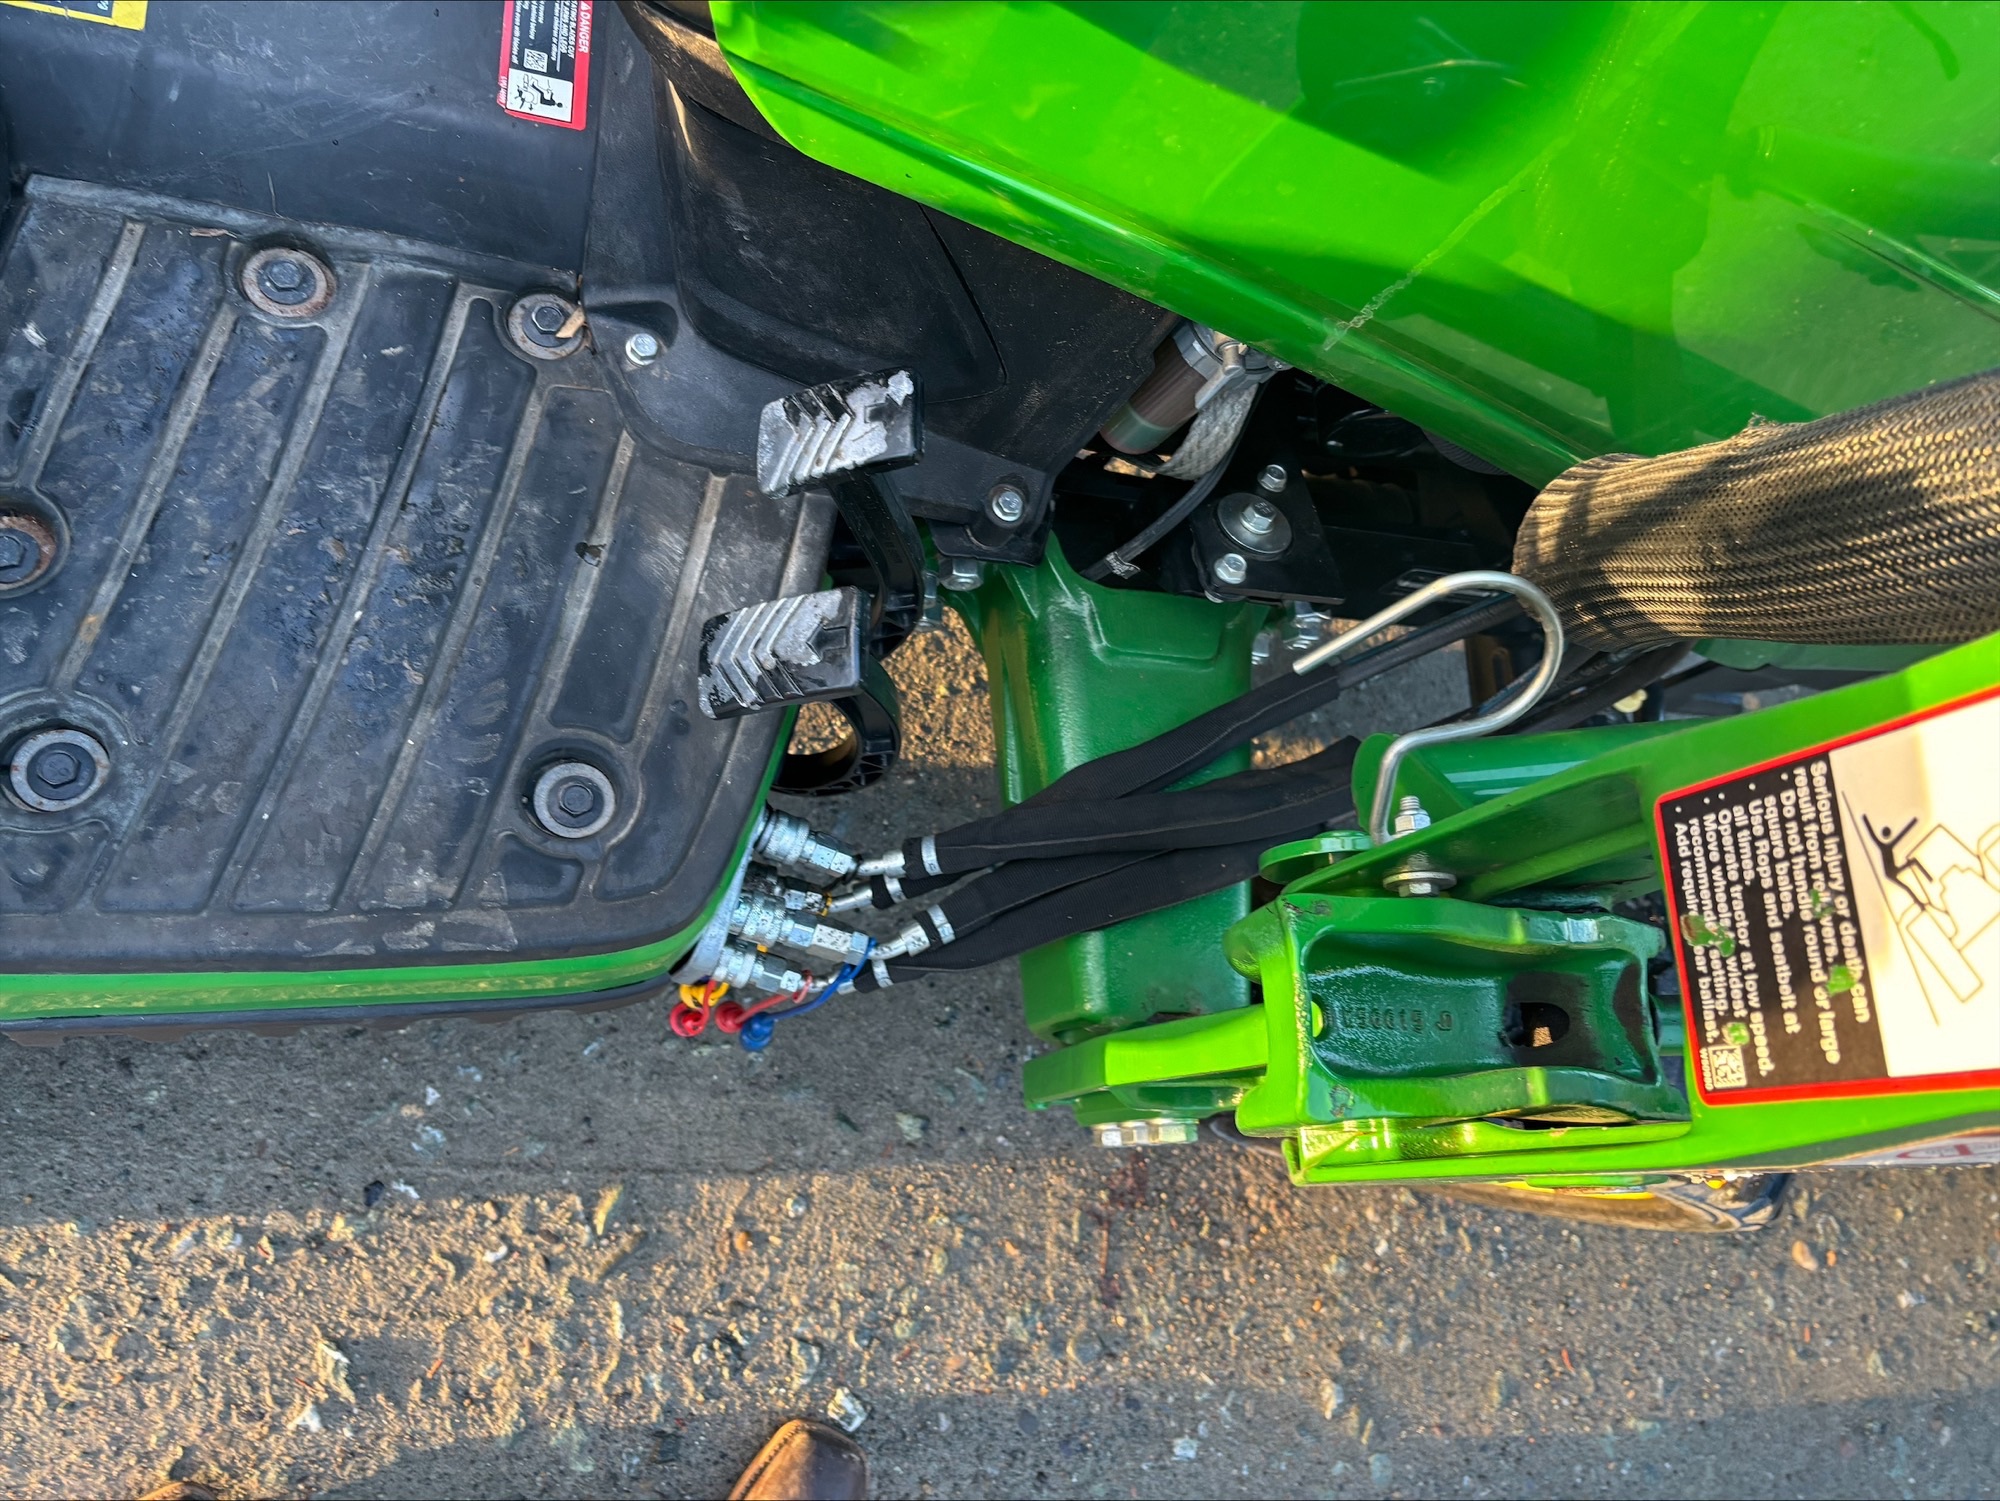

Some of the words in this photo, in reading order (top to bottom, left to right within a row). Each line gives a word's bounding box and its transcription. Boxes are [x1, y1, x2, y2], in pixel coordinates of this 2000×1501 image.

[568, 22, 576, 45] BLADES
[578, 12, 591, 53] DANGER
[1732, 805, 1749, 827] all
[1748, 799, 1765, 836] Use
[1779, 789, 1796, 818] Do
[1792, 767, 1816, 822] result
[1810, 761, 1834, 835] Serious
[1674, 822, 1691, 858] Add
[1703, 813, 1720, 862] Move
[1718, 809, 1739, 881] Operate
[1737, 829, 1755, 885] times.
[1764, 795, 1785, 859] square
[1775, 861, 1794, 919] bales.
[1785, 821, 1804, 854] not
[1803, 823, 1822, 870] from
[1823, 836, 1845, 890] injury
[1754, 839, 1773, 889] Rops
[1791, 855, 1814, 922] handle
[1689, 818, 1720, 936] recommende
[1708, 949, 1729, 1016] setting.
[1711, 865, 1732, 928] wheels
[1730, 884, 1750, 948] tractor
[1763, 892, 1783, 928] and
[1811, 872, 1839, 963] rollvers.
[1834, 895, 1851, 918] or
[1693, 945, 1708, 974] ear
[1740, 952, 1756, 970] at
[1769, 931, 1797, 1009] seatbelt
[1802, 925, 1828, 983] round
[1839, 921, 1864, 982] death
[1698, 977, 1719, 1043] ballast.
[1726, 956, 1748, 1018] widest
[1744, 973, 1760, 1008] low
[1813, 986, 1830, 1009] or
[1850, 983, 1870, 1023] can
[1749, 1011, 1775, 1077] speed.
[1783, 1012, 1801, 1034] at
[1818, 1011, 1841, 1064] large
